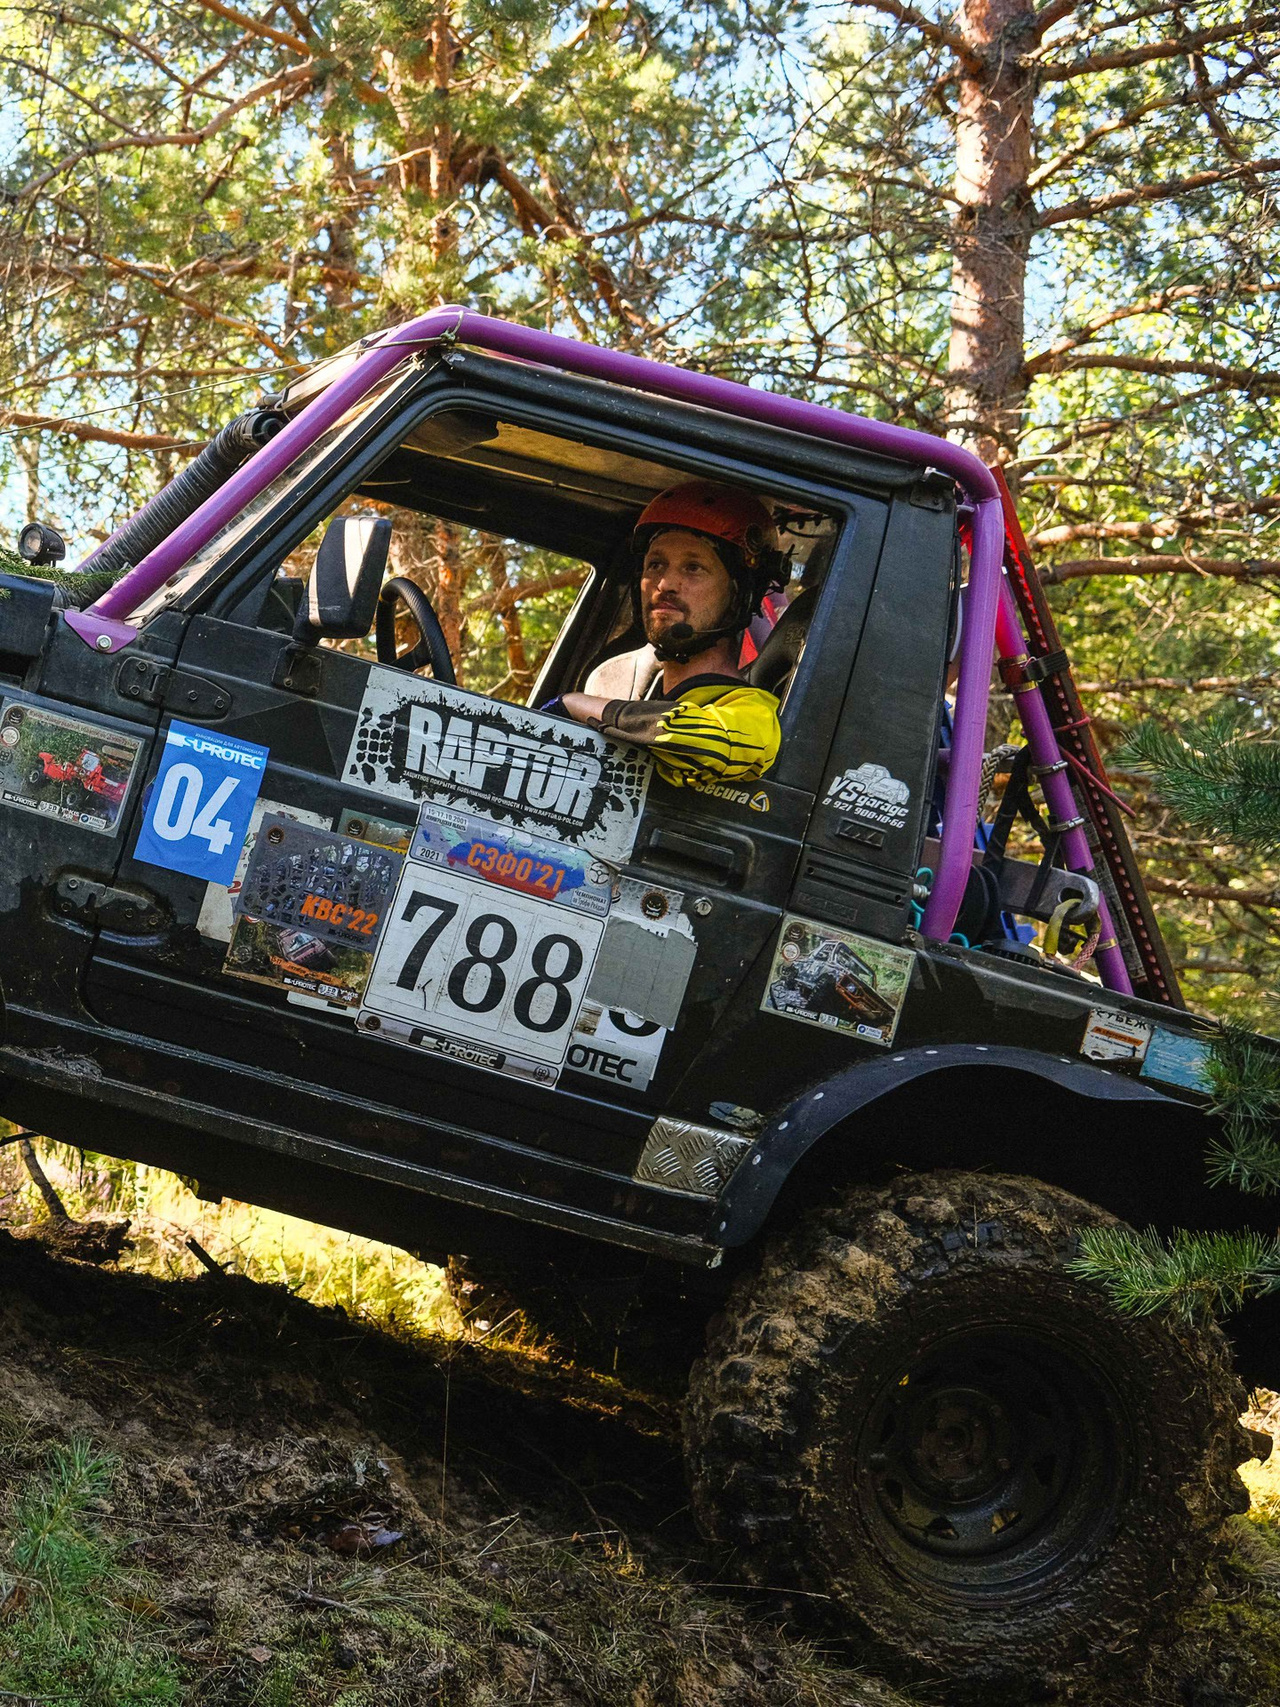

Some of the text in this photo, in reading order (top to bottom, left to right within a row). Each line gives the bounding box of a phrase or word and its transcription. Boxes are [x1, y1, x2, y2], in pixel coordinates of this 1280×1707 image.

[180, 735, 262, 770] SUPROTEC
[405, 704, 602, 820] RAPTOR
[152, 763, 241, 854] 04
[833, 800, 851, 812] 921
[857, 794, 909, 817] garage
[420, 848, 440, 861] 2021
[396, 891, 584, 1033] 788
[432, 1039, 497, 1067] SUPROTEC
